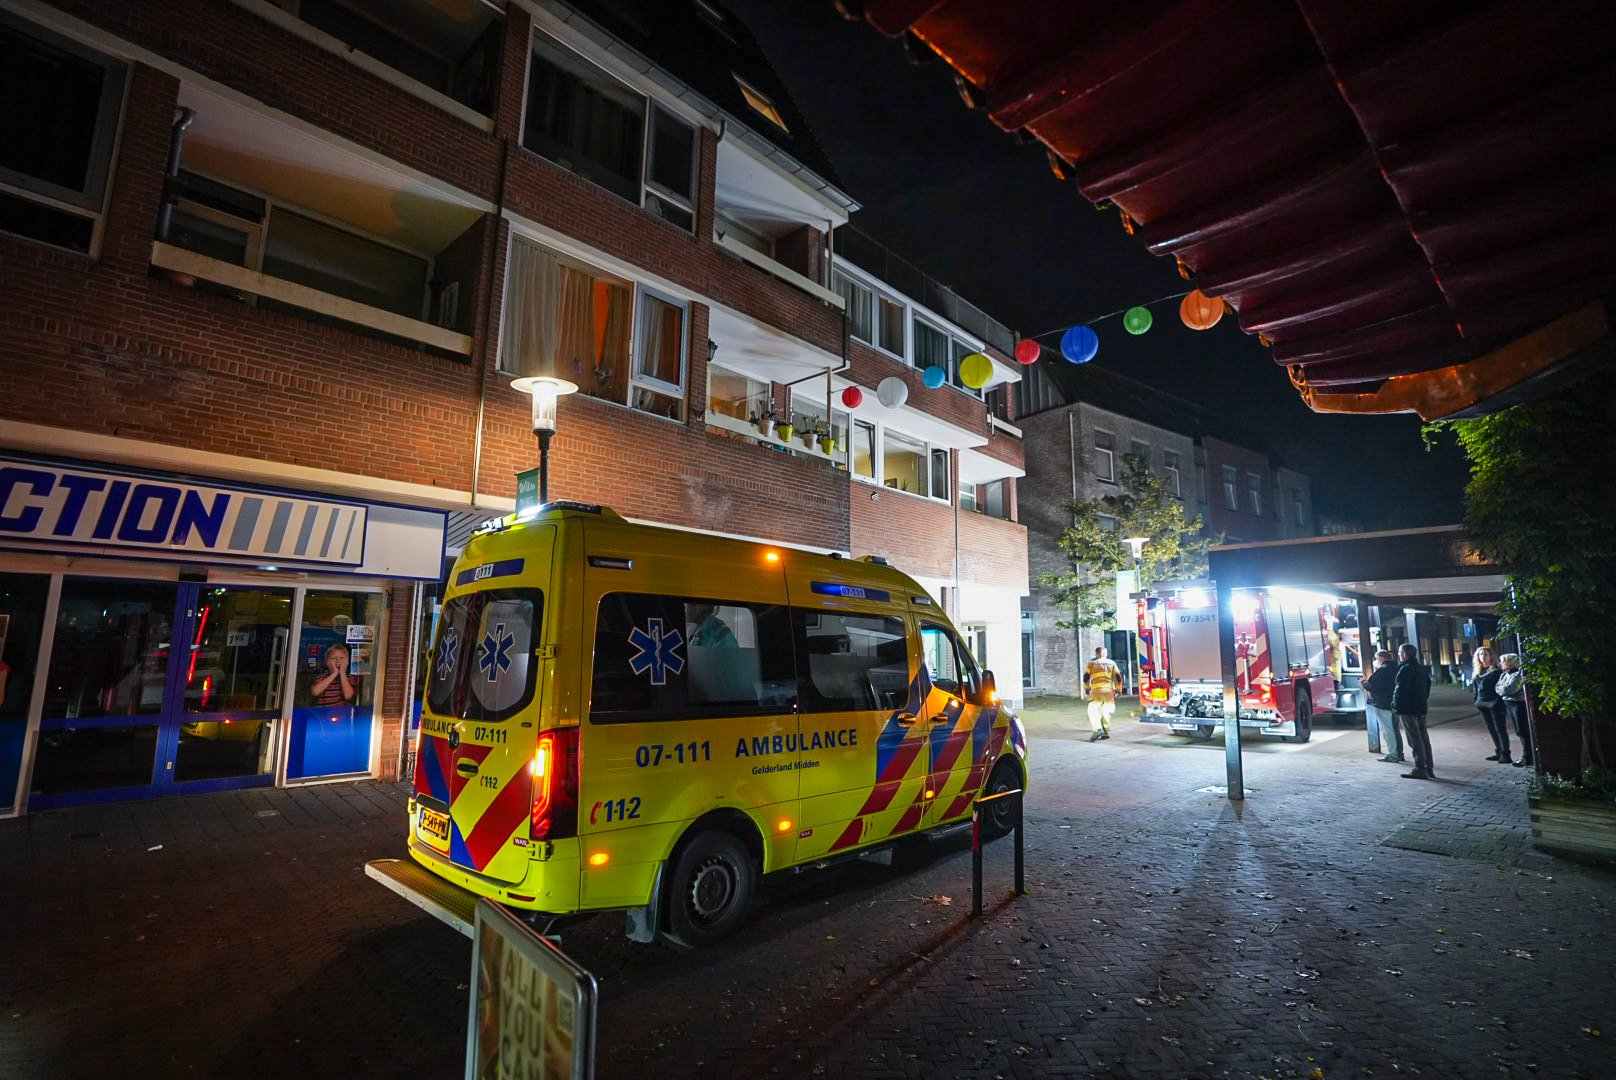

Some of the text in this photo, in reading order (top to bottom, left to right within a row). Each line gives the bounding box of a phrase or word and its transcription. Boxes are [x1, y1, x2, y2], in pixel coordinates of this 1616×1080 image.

[0, 467, 231, 548] CTION
[1180, 614, 1216, 623] 07-3541
[474, 727, 507, 743] 07-111
[735, 728, 858, 758] AMBULANCE
[636, 741, 711, 767] 07-111
[751, 759, 820, 775] Gelderland Midden
[503, 948, 542, 1014] ALL
[502, 988, 541, 1059] YOU
